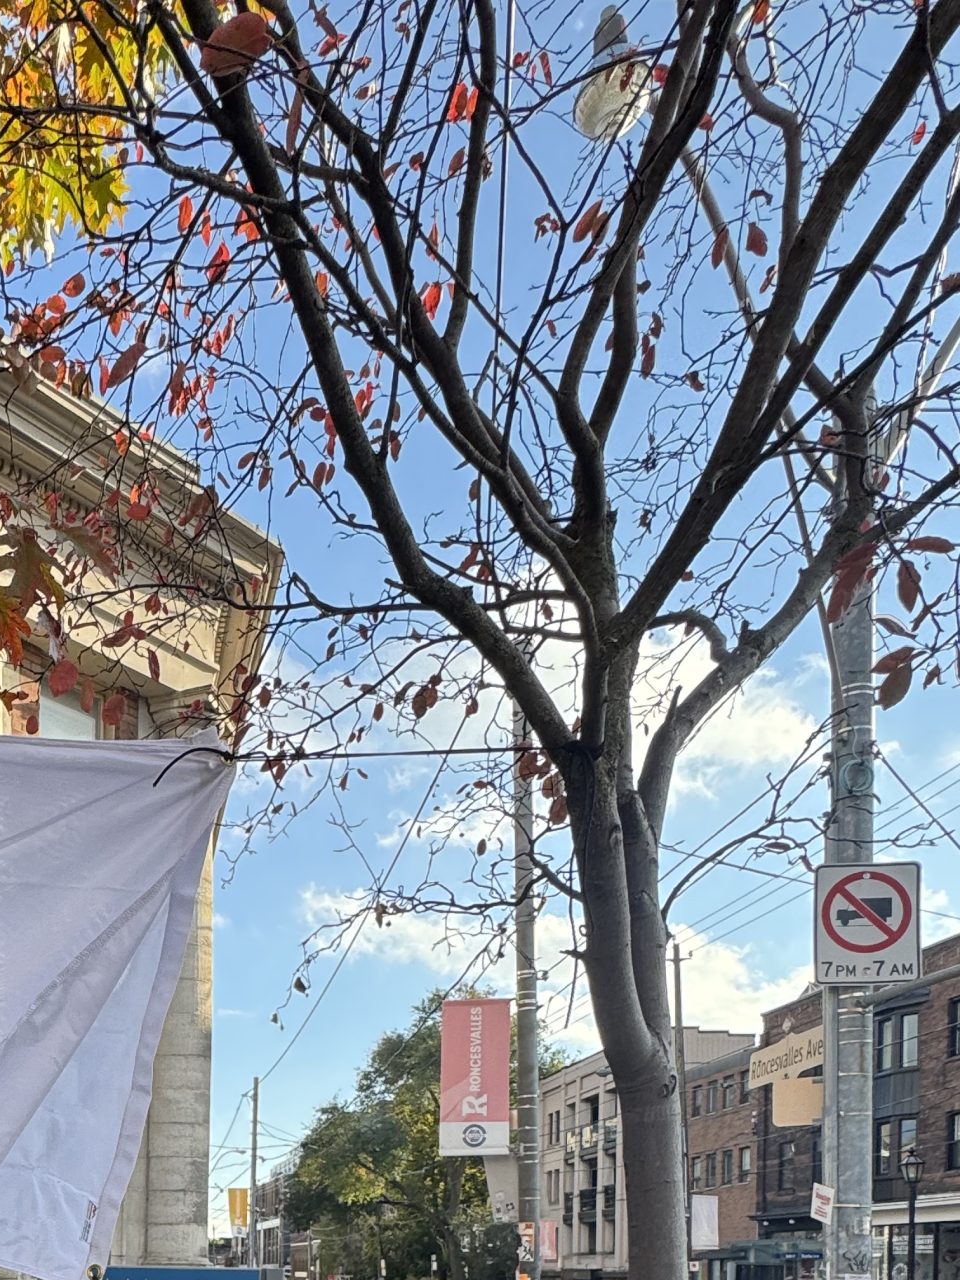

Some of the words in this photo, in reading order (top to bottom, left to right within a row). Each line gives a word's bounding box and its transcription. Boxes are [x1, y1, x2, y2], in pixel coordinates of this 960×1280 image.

[469, 1007, 483, 1092] RONCESVALLES
[751, 1045, 803, 1080] Roncesvalles
[806, 1039, 823, 1061] Ave
